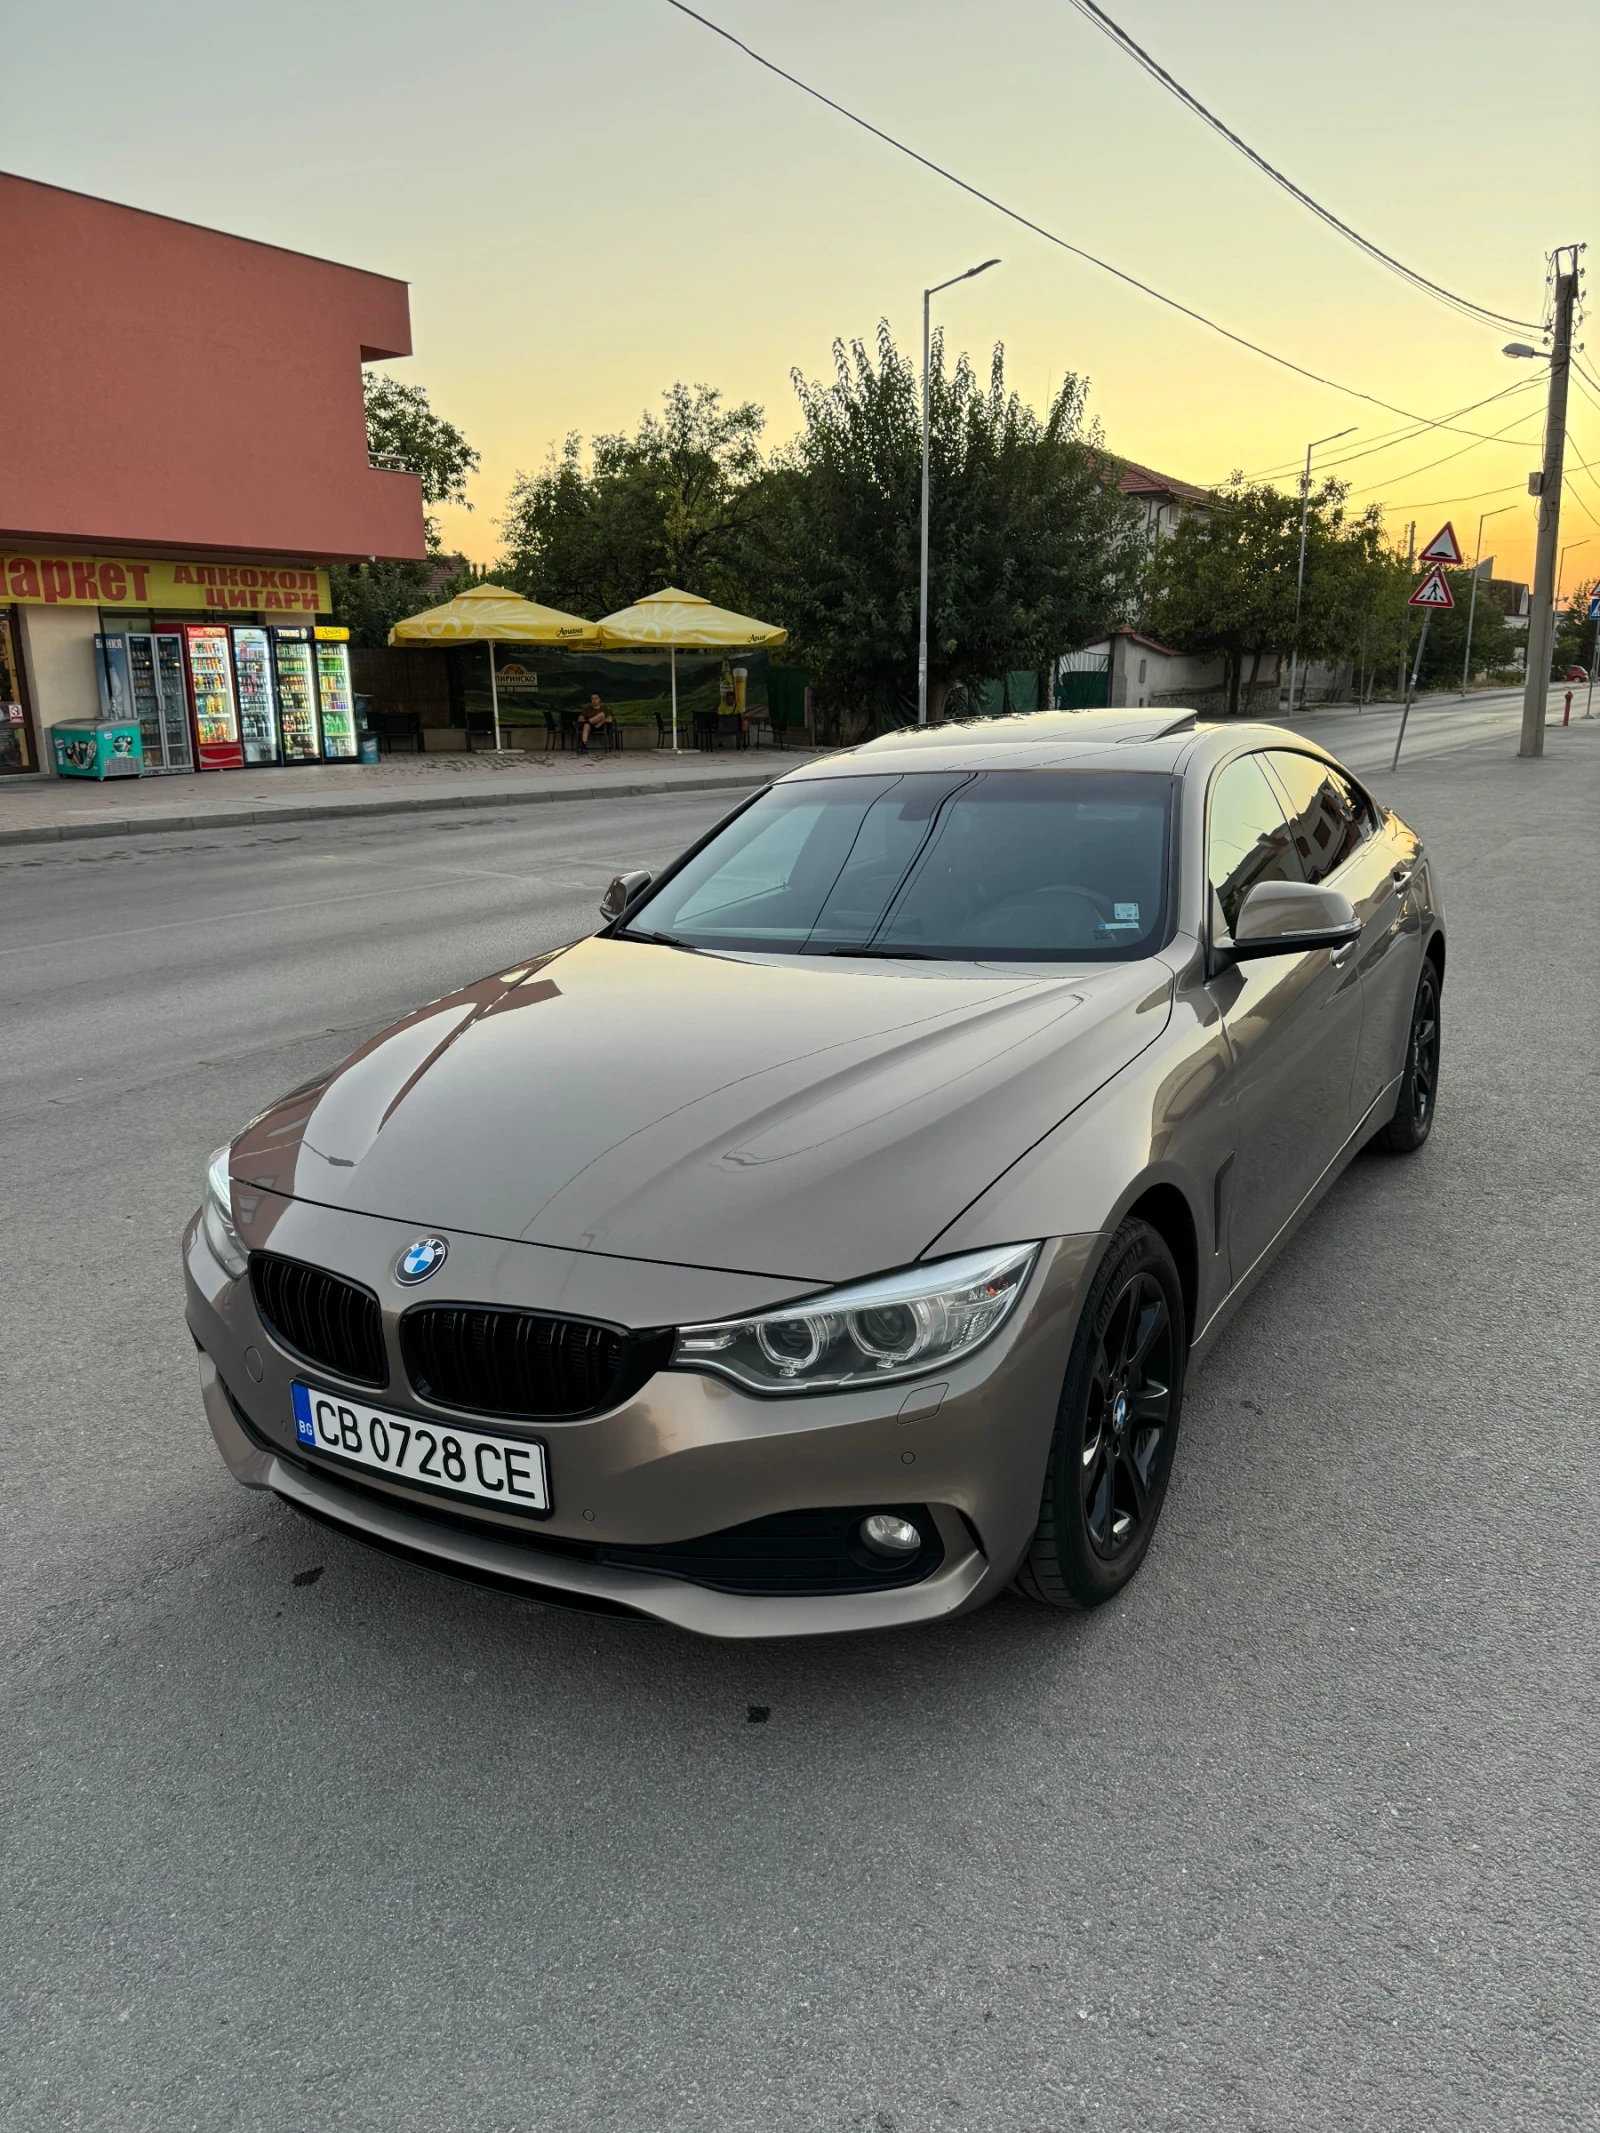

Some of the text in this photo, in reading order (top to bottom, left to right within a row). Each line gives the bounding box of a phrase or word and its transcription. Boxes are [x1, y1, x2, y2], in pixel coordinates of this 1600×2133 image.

[173, 565, 318, 590] АЛКОХОЛ
[205, 588, 320, 610] ЦИГАРИ
[495, 675, 536, 683] ПИРИНСКО
[411, 1239, 443, 1255] BMW
[298, 1420, 313, 1436] BG
[316, 1400, 536, 1499] CB 0728 CE
